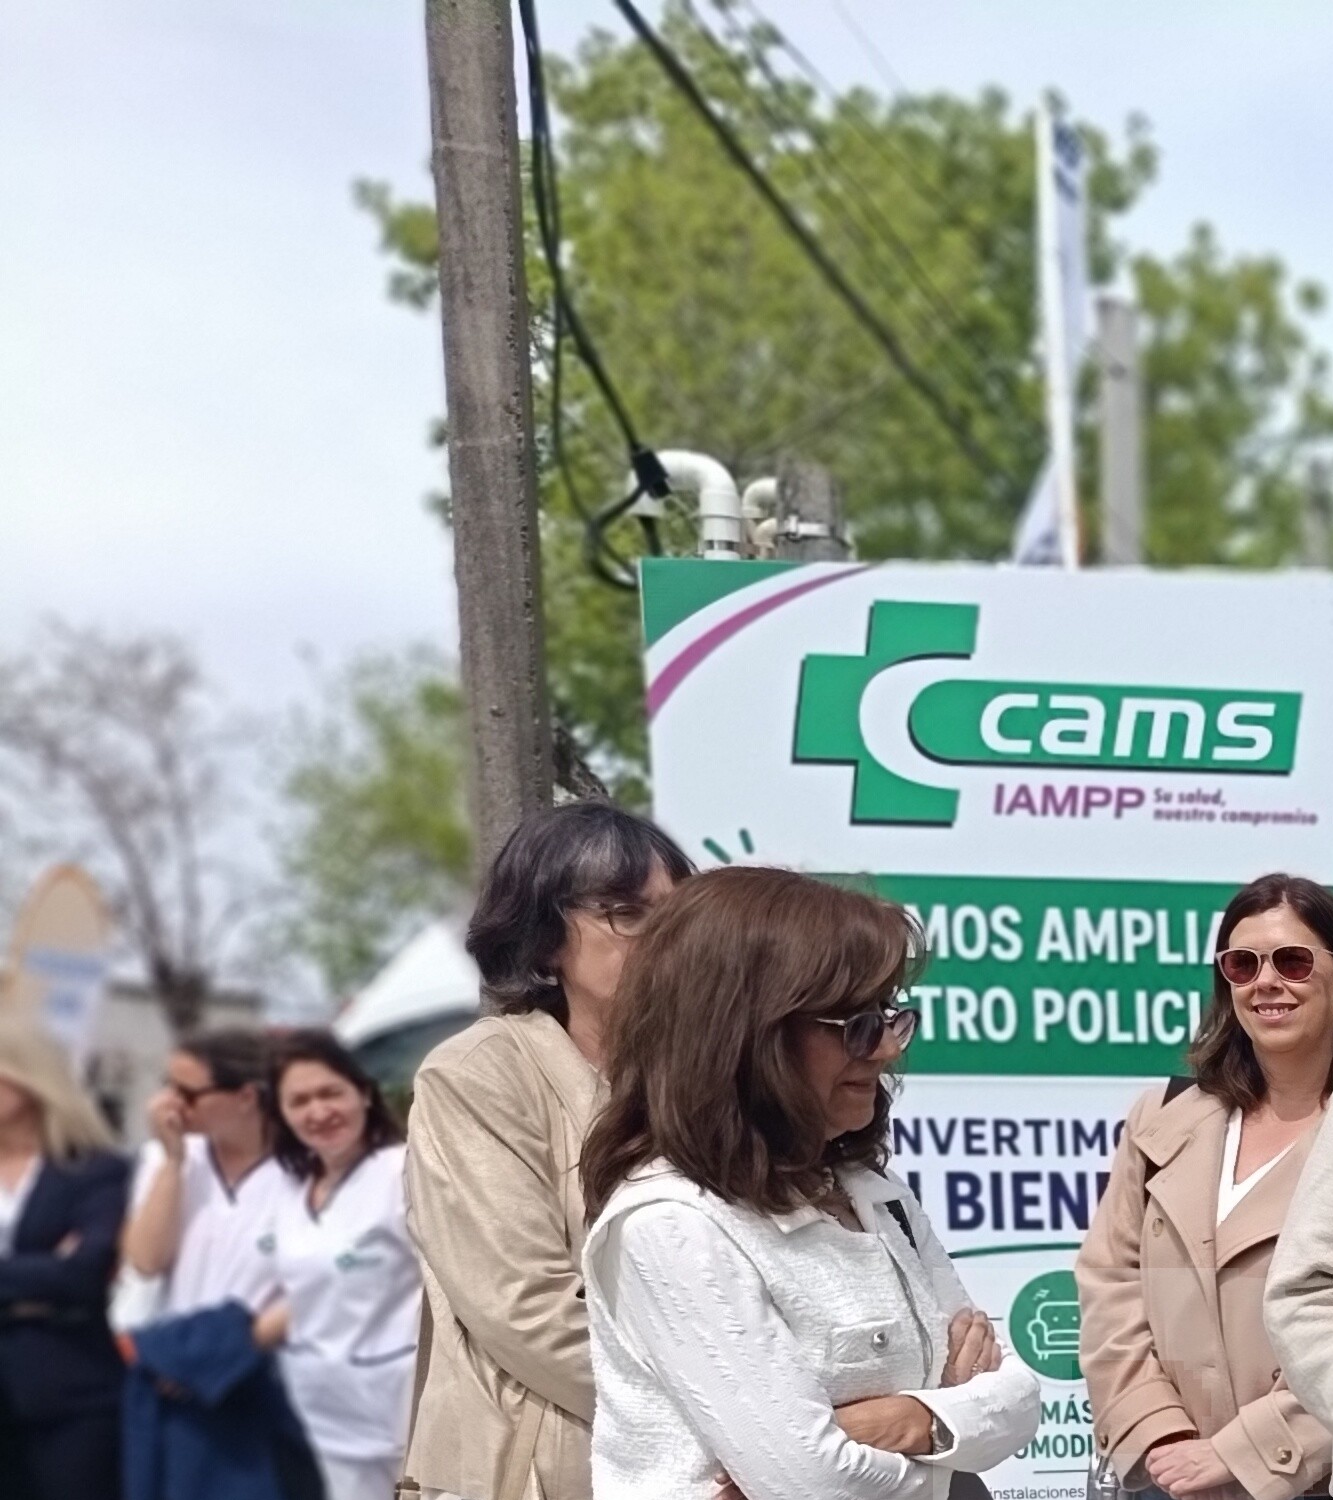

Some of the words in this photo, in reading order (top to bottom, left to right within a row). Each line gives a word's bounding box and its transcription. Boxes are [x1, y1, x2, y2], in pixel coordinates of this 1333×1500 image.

[979, 692, 1276, 762] cams
[993, 782, 1146, 819] IAMPP
[1153, 787, 1173, 803] Su
[1178, 787, 1227, 808] salud,
[1153, 808, 1217, 823] nuestro
[1221, 808, 1319, 827] compromiso
[897, 984, 1018, 1042] TRO
